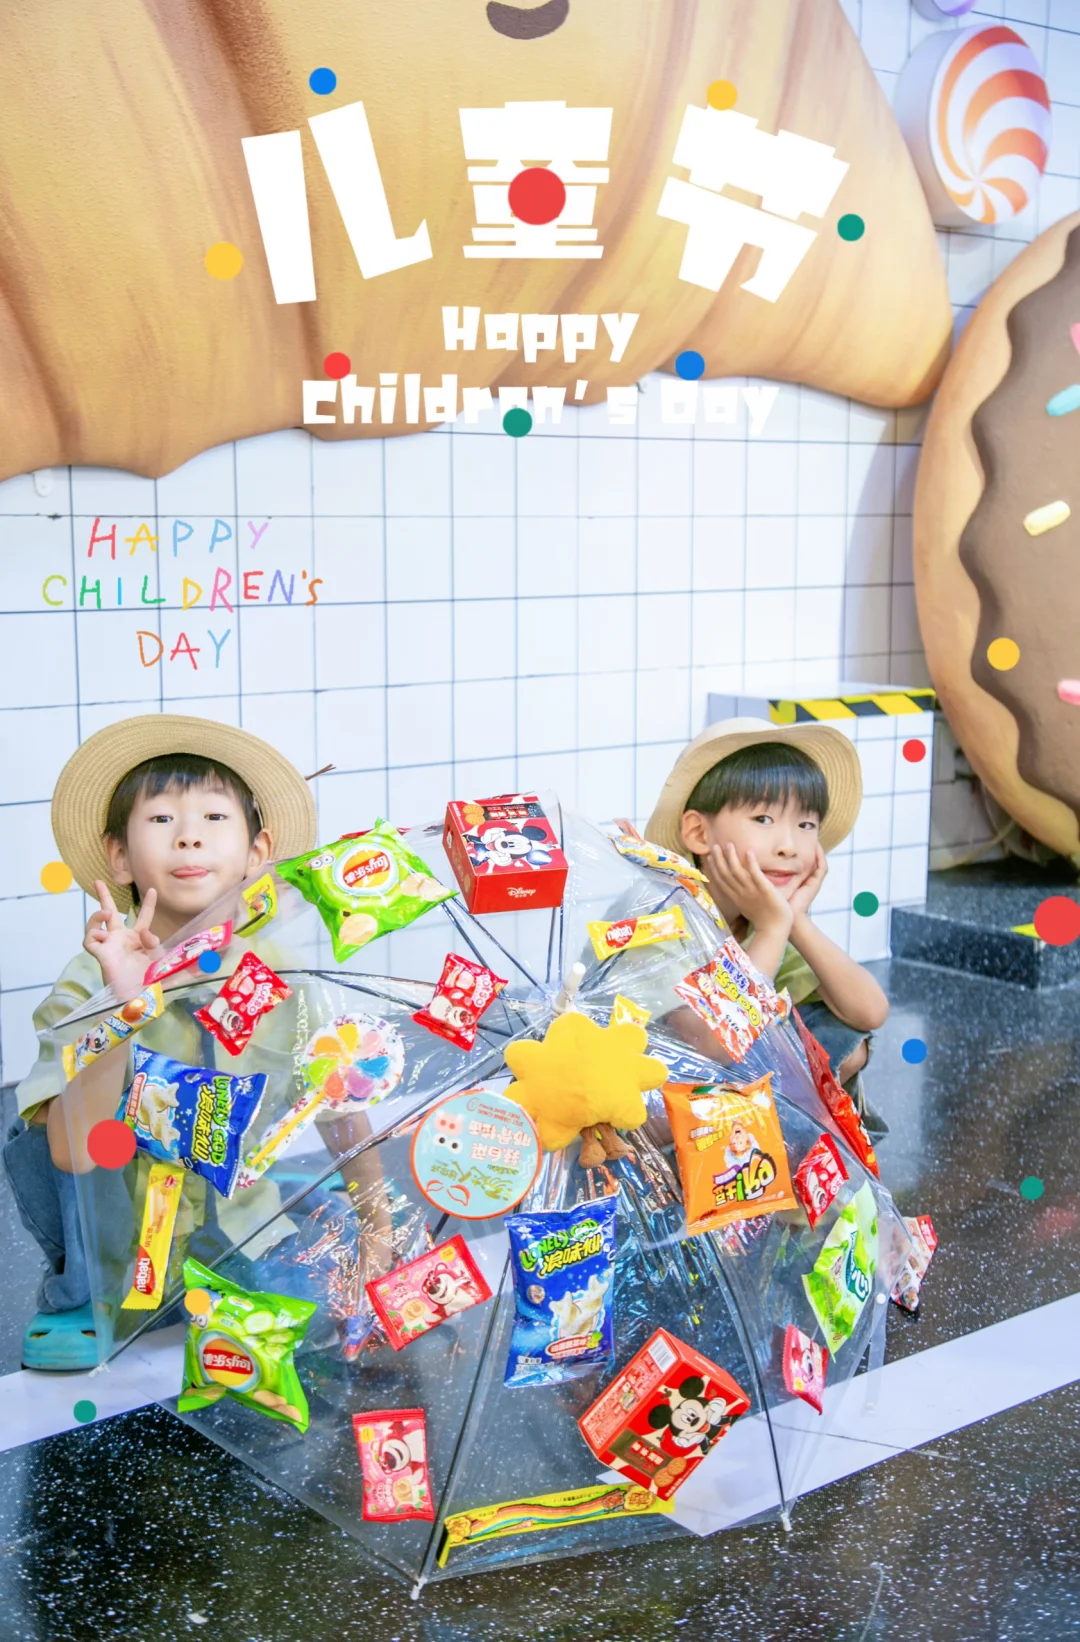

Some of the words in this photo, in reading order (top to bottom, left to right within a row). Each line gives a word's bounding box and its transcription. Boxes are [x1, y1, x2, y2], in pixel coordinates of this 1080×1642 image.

[191, 1084, 214, 1161] 浪味仙
[213, 1076, 232, 1127] LONELY
[212, 1128, 229, 1166] GOD
[134, 1256, 151, 1293] nabati
[540, 1234, 602, 1276] 浪味仙
